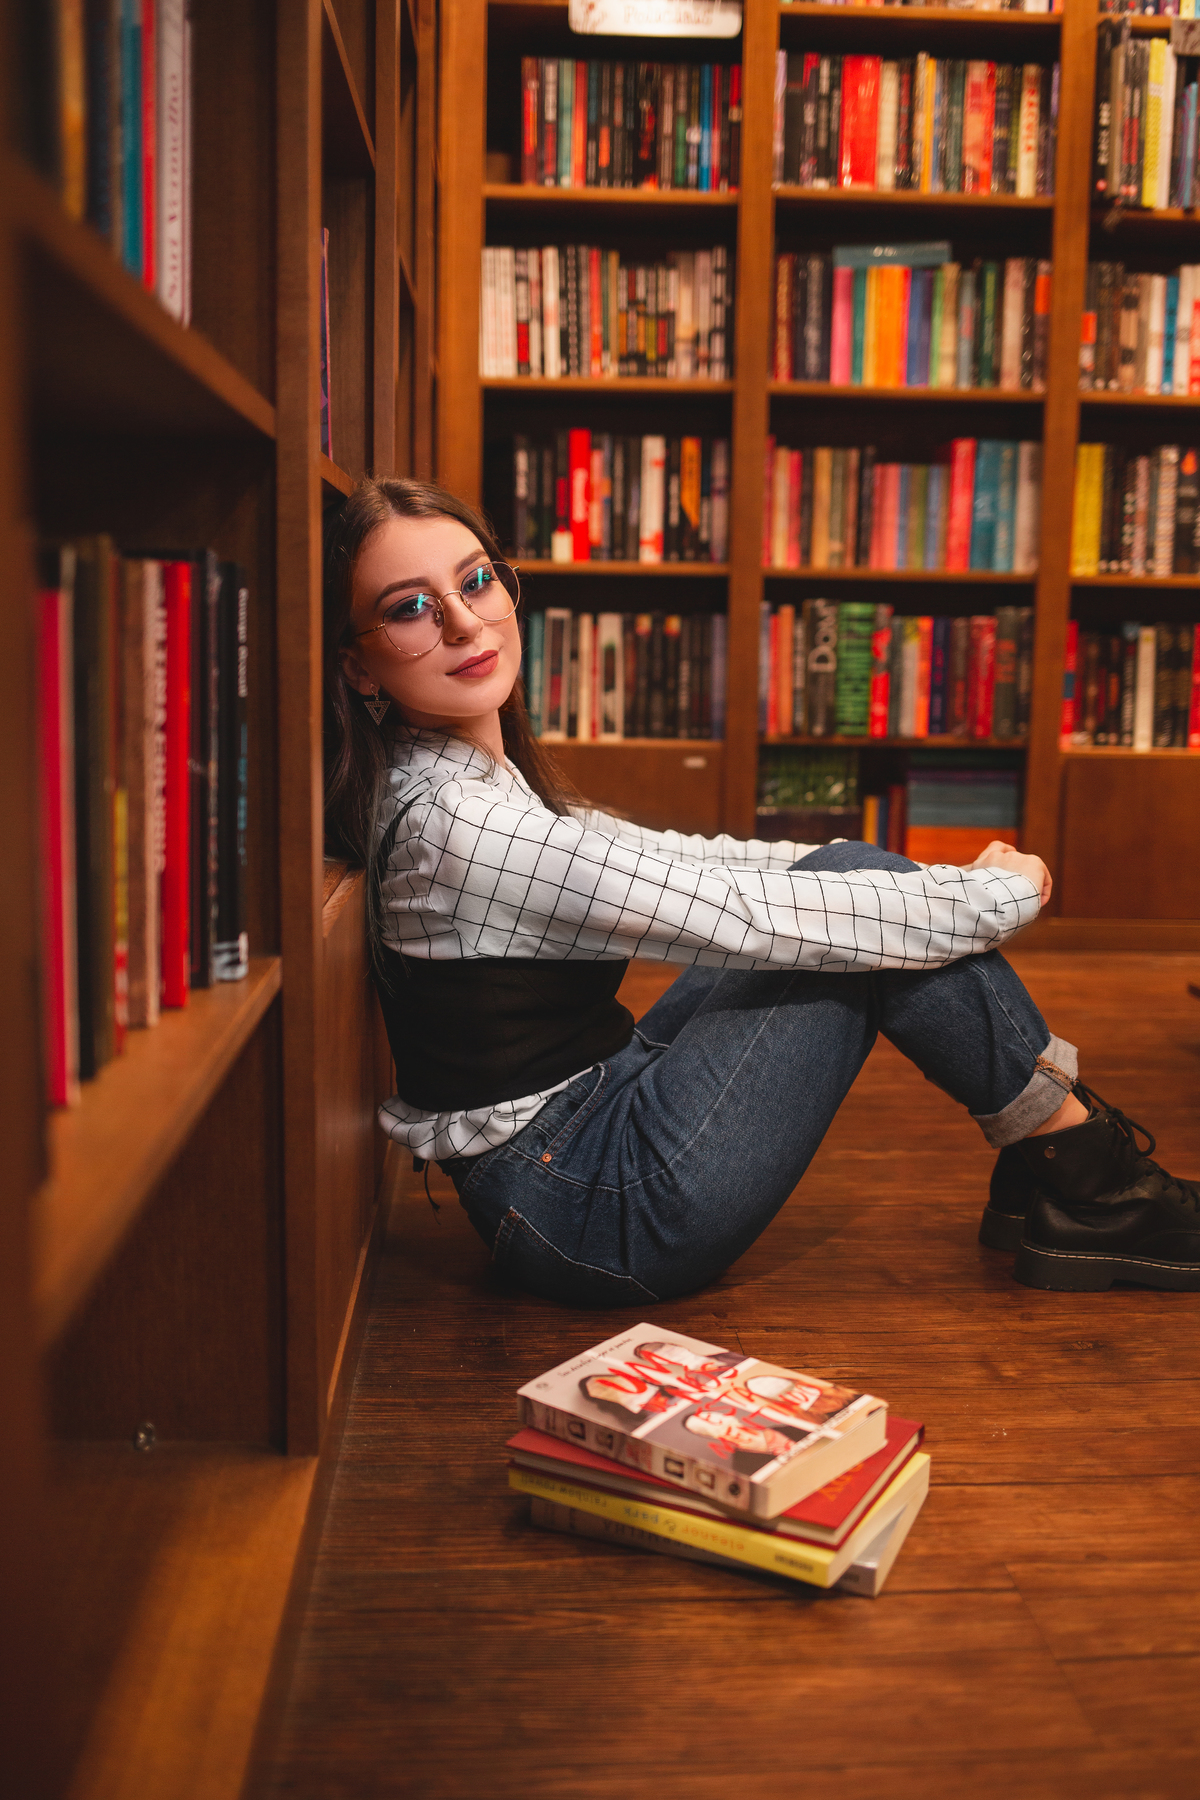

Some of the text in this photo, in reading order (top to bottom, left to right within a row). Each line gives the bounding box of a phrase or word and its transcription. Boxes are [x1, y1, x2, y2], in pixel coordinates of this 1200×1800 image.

[597, 1350, 684, 1395] UM
[623, 1505, 660, 1525] park
[681, 1524, 745, 1551] eleanor
